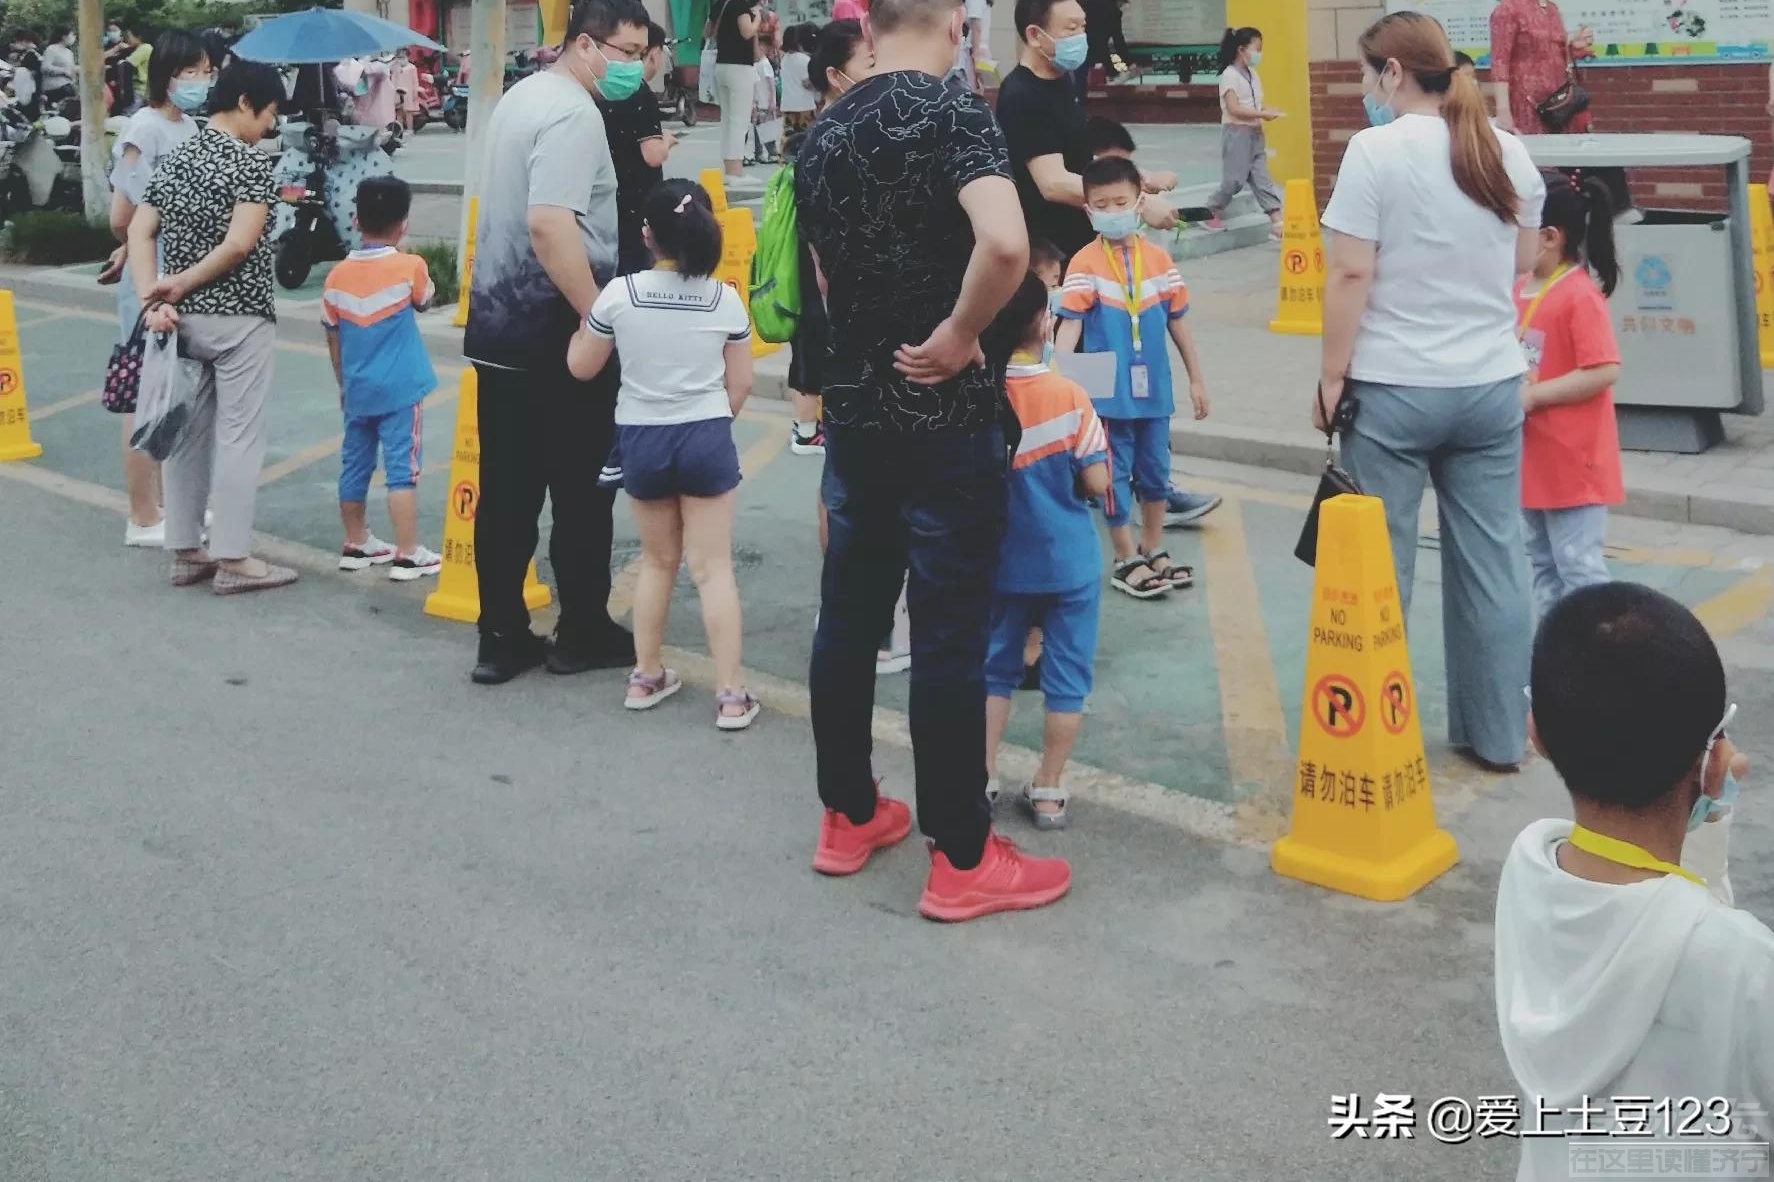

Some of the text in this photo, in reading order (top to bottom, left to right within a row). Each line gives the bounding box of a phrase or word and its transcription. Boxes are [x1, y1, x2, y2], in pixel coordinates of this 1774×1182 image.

[647, 291, 702, 302] HELLO KITTY
[1330, 607, 1346, 626] NO
[1313, 626, 1363, 652] PARKING
[1300, 760, 1376, 813] 请勿泊车
[1382, 757, 1426, 813] 请勿泊车
